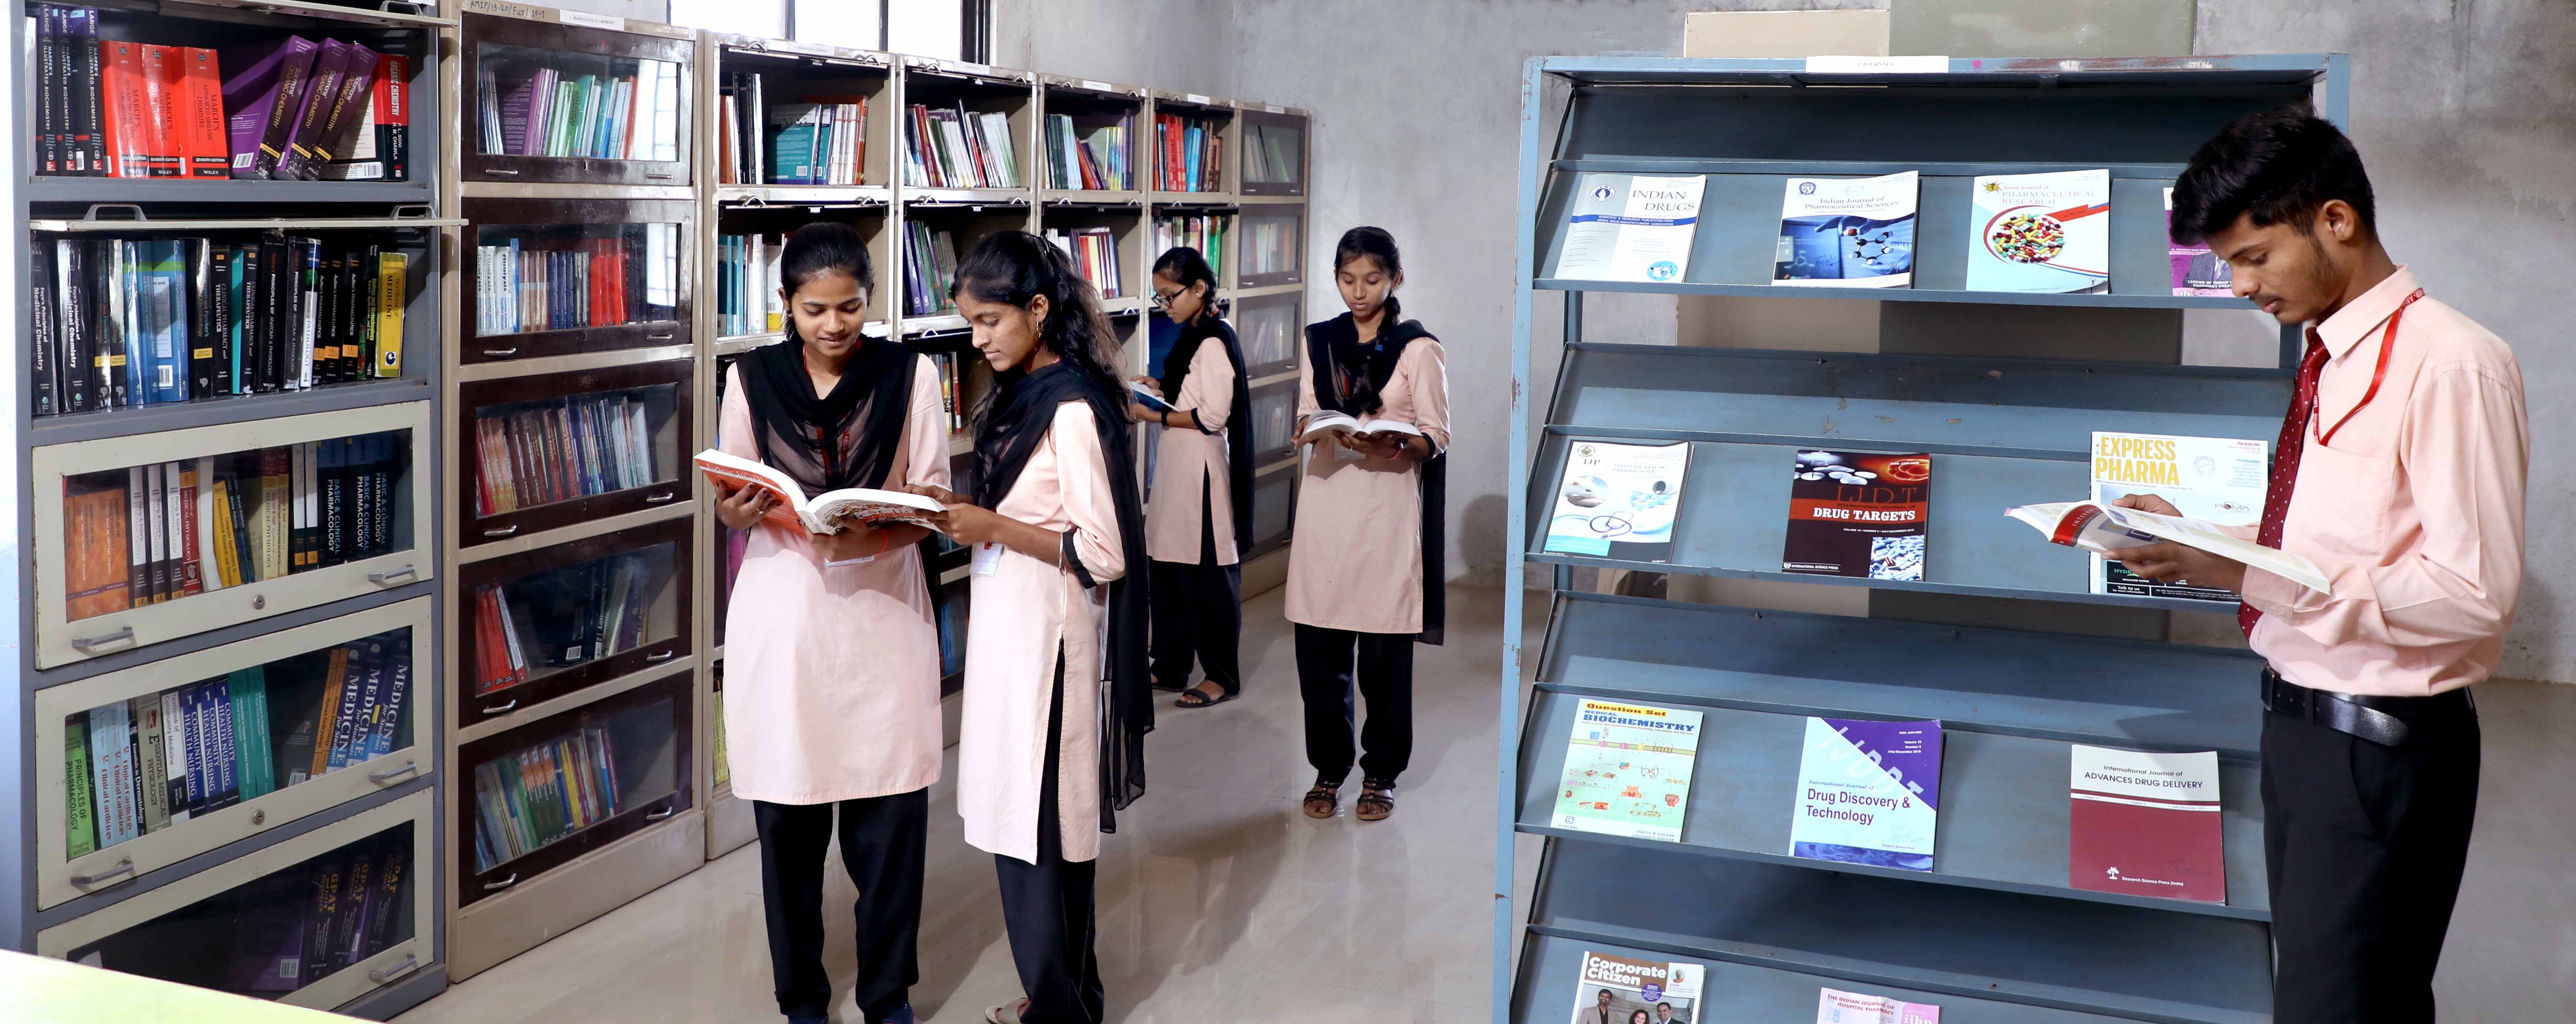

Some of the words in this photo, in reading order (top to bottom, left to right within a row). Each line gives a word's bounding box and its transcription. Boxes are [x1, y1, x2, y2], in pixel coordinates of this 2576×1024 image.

[390, 61, 399, 84] ORGANIC
[210, 94, 220, 131] MARCH'S
[273, 93, 287, 128] CHEMISTRY
[391, 84, 399, 116] CHEMISTRY
[1633, 190, 1687, 199] INDIAN
[1644, 202, 1695, 211] DRUGS
[2101, 437, 2177, 461] EXPRESS
[2095, 456, 2180, 486] PHARMA
[1813, 507, 1850, 519] DRUG
[1853, 510, 1916, 521] TARGETS
[187, 695, 192, 705] 1
[205, 691, 210, 701] 1
[221, 686, 226, 696] 1
[336, 675, 360, 764] MEDICINE
[355, 668, 380, 756] MEDICINE
[381, 665, 408, 752] MEDICINE
[1583, 714, 1694, 732] BIOCHEMISTRY
[1587, 703, 1641, 714] Question
[1645, 709, 1667, 717] Set
[174, 724, 179, 732] of
[184, 714, 193, 751] HEALTH
[191, 712, 203, 770] COMMUNITY
[209, 707, 220, 766] COMMUNITY
[224, 702, 236, 761] COMMUNITY
[349, 723, 360, 756] Students
[374, 716, 386, 750] Students
[202, 710, 210, 746] HEALTH
[206, 748, 216, 791] NURSING
[330, 729, 341, 764] Students
[149, 734, 164, 780] ESSENTIAL
[158, 781, 168, 818] MEDICAL
[187, 753, 197, 796] NURSING
[222, 742, 231, 786] NURSING
[2085, 772, 2132, 784] ADVANCES
[2135, 778, 2160, 786] DRUG
[2104, 765, 2147, 775] International
[66, 761, 78, 830] PHARMACOLOGY
[75, 759, 85, 804] PRINCIPLES
[147, 758, 158, 806] PHYSIOLOGY
[79, 805, 87, 820] OF
[135, 776, 144, 824] Dermatology
[1806, 805, 1874, 825] Technology
[1807, 788, 1835, 805] Drug
[1840, 791, 1898, 811] Discovery
[1902, 796, 1911, 808] &
[327, 873, 339, 913] GPAT
[1587, 968, 1641, 986] Citizen
[1589, 957, 1666, 978] Corporate
[1837, 1002, 1864, 1011] HOSPITAL
[1865, 1007, 1894, 1016] PHARMACY
